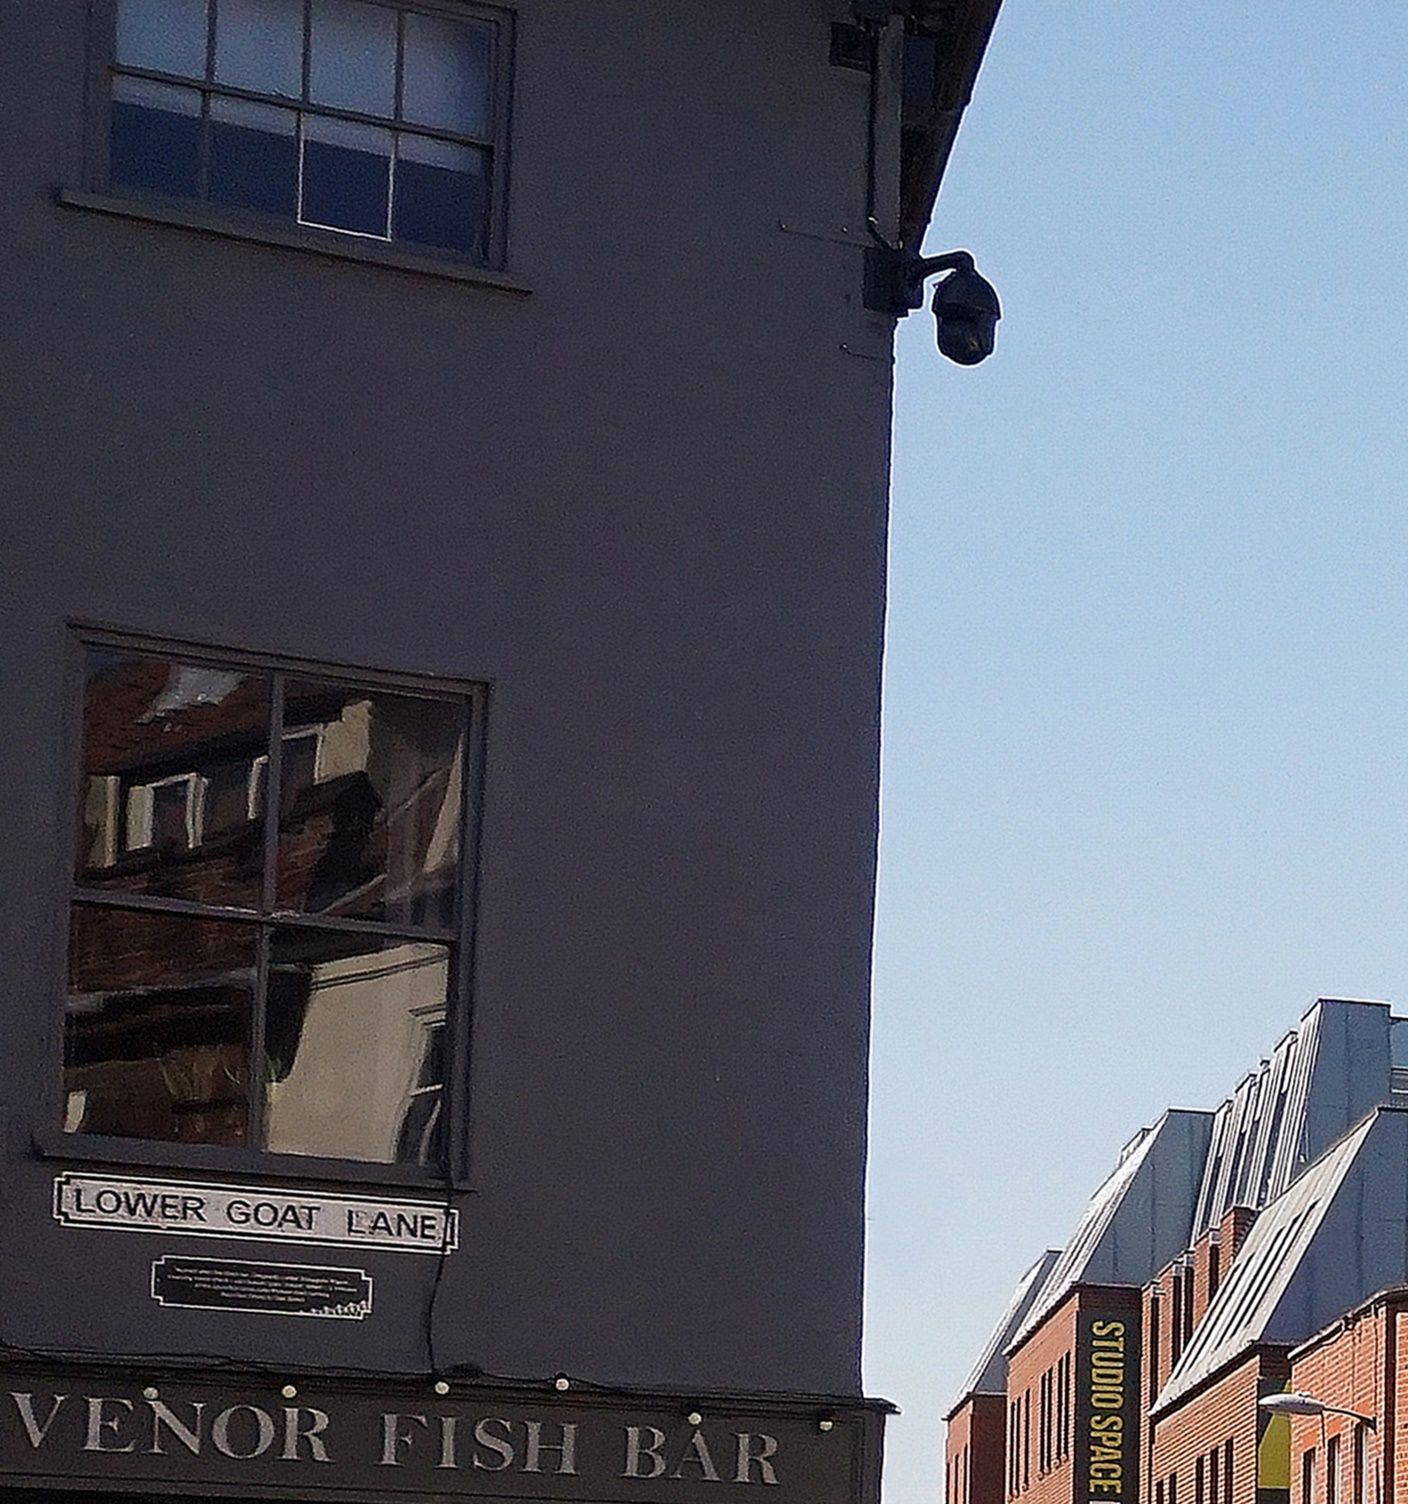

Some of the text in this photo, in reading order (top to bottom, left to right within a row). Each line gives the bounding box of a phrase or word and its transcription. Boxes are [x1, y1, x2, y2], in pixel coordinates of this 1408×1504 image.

[74, 1187, 438, 1241] LOWER GOAT LANE
[1090, 1321, 1126, 1409] STUDIO
[8, 1391, 781, 1486] VENOR FISH BAR
[1088, 1415, 1124, 1494] SPACE
